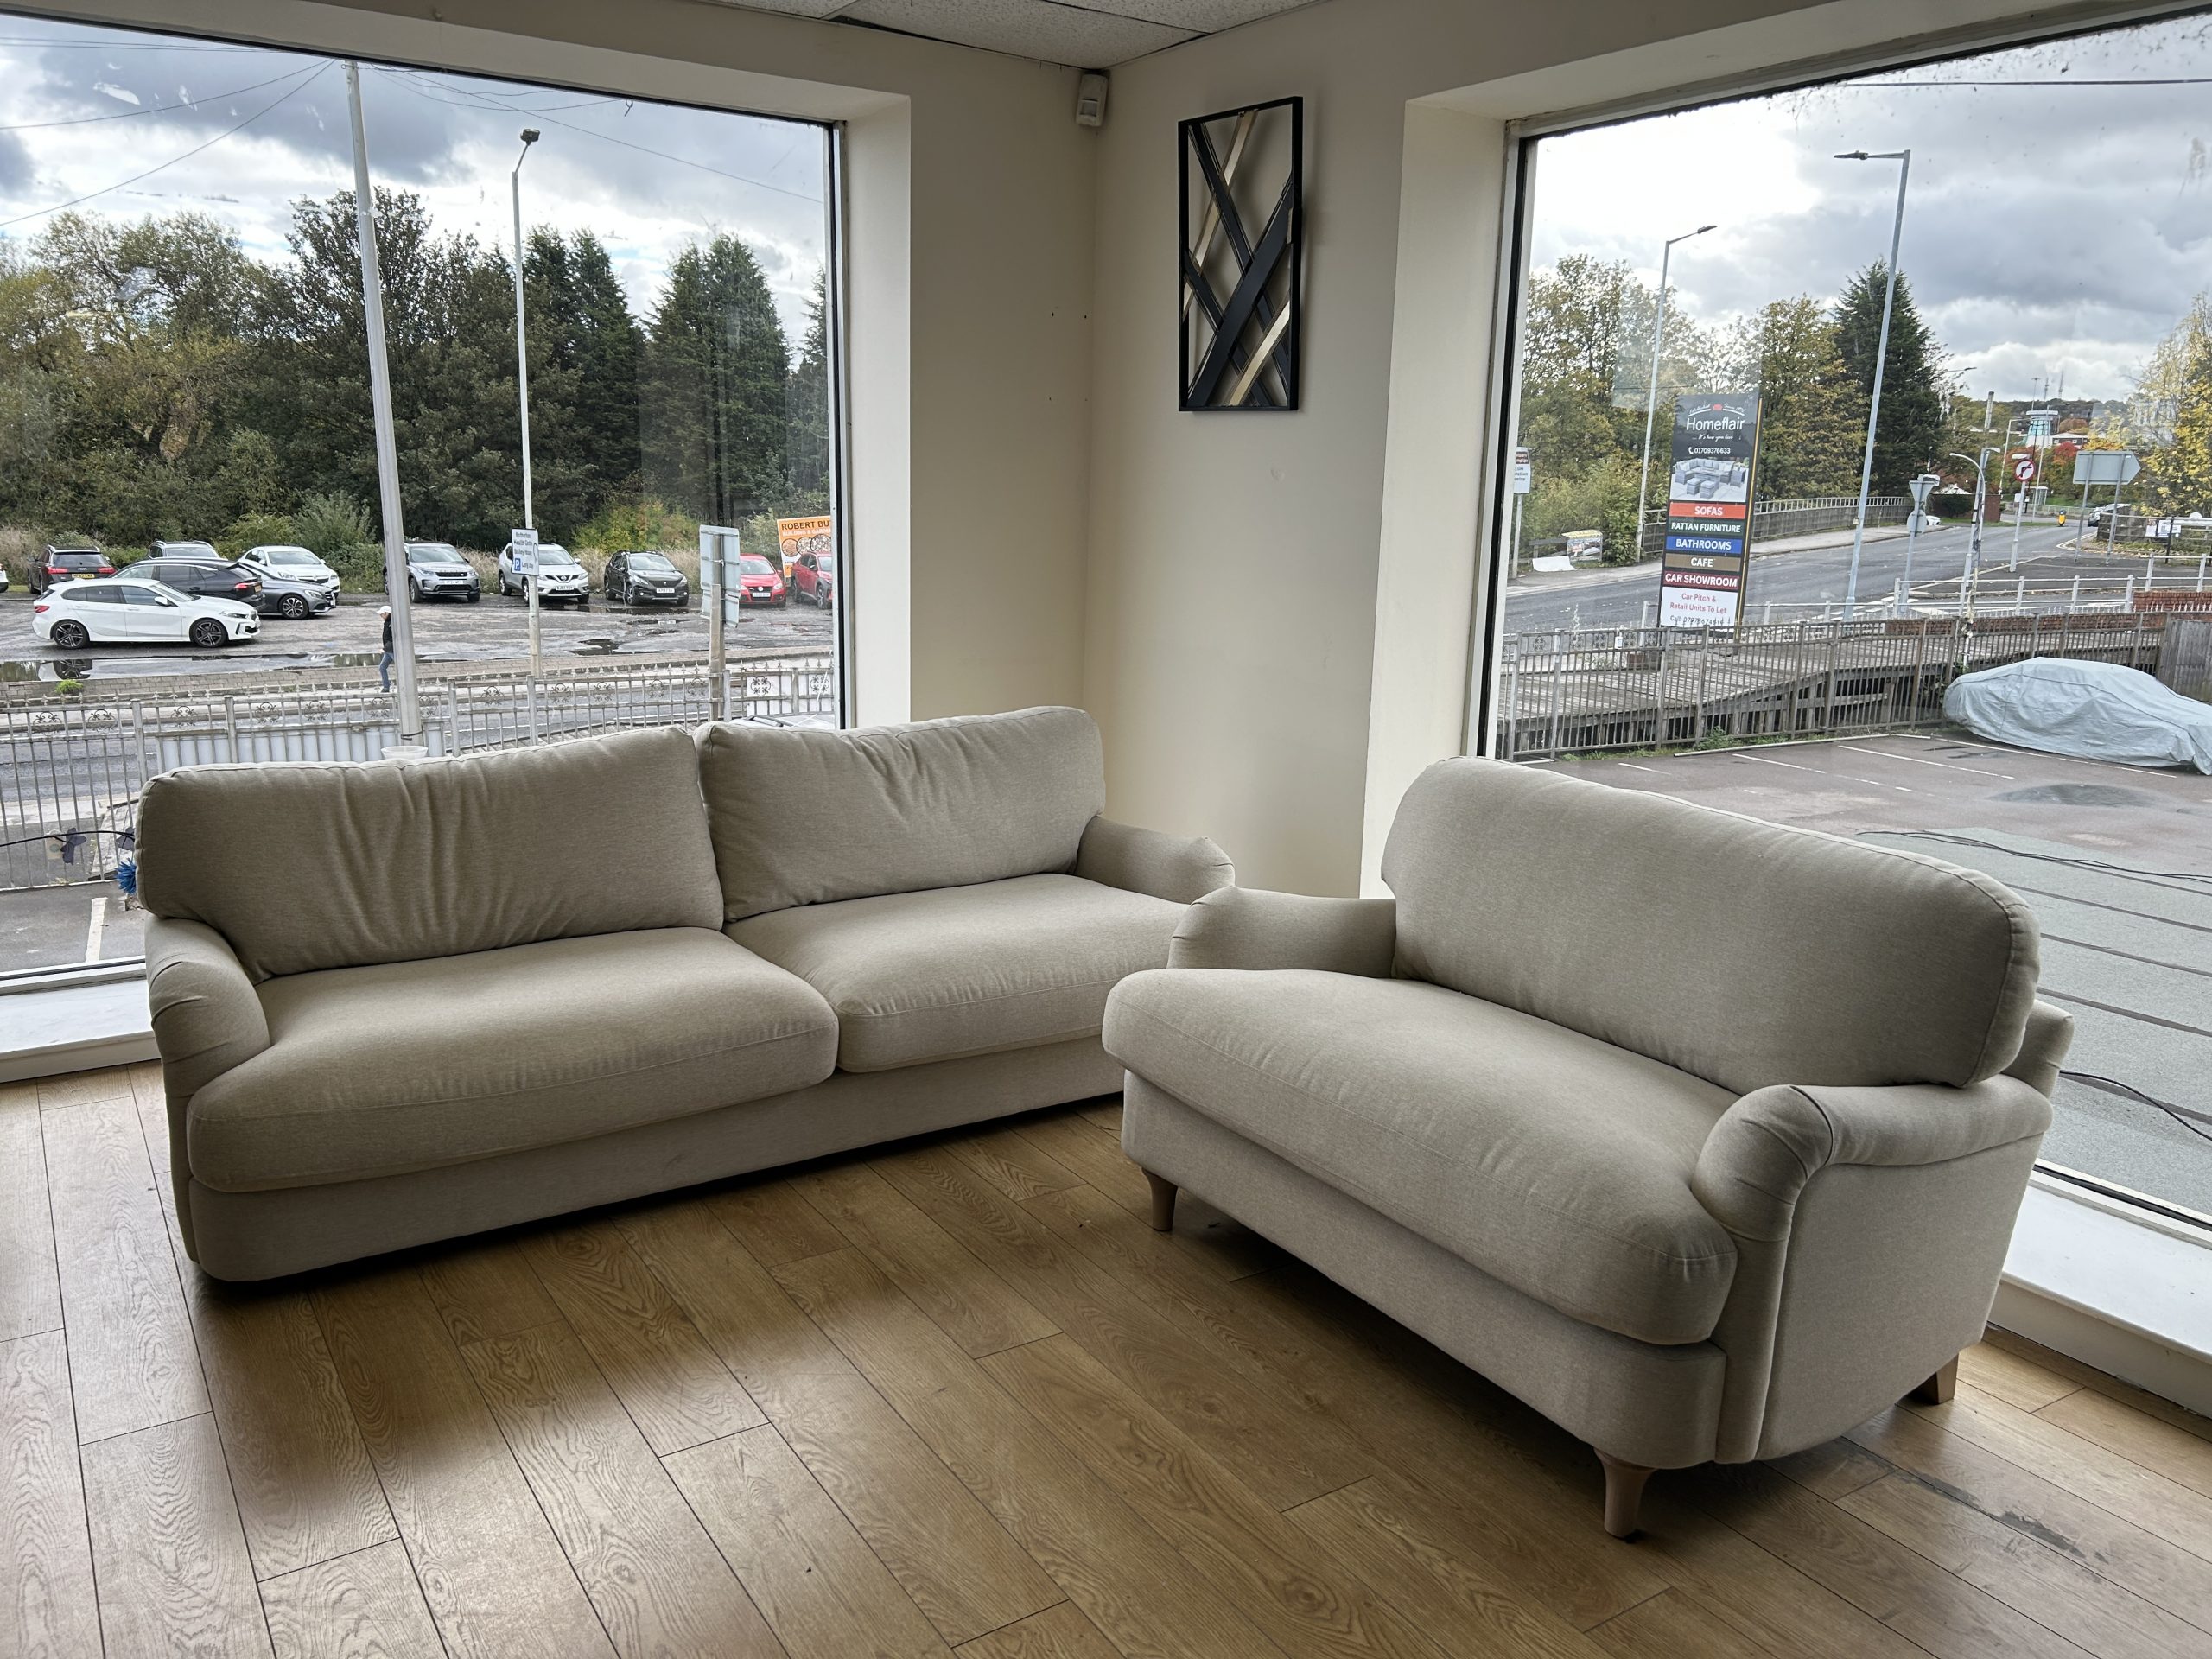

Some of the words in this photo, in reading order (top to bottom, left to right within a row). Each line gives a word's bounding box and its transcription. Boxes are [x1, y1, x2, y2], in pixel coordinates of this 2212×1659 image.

[1686, 416, 1745, 430] Homeflair
[1694, 505, 1723, 516] SOFAS
[781, 521, 816, 531] ROBERT
[1671, 522, 1699, 531] RATTAN
[1700, 523, 1741, 532] FURNITURE
[1675, 538, 1732, 550] BATHROOMS
[1690, 556, 1713, 568] CAFE
[1665, 573, 1682, 582] CAR
[1683, 575, 1738, 588] SHOWROOM
[1694, 594, 1710, 602] Pitch
[1669, 601, 1688, 610] Retail
[1707, 605, 1715, 613] To
